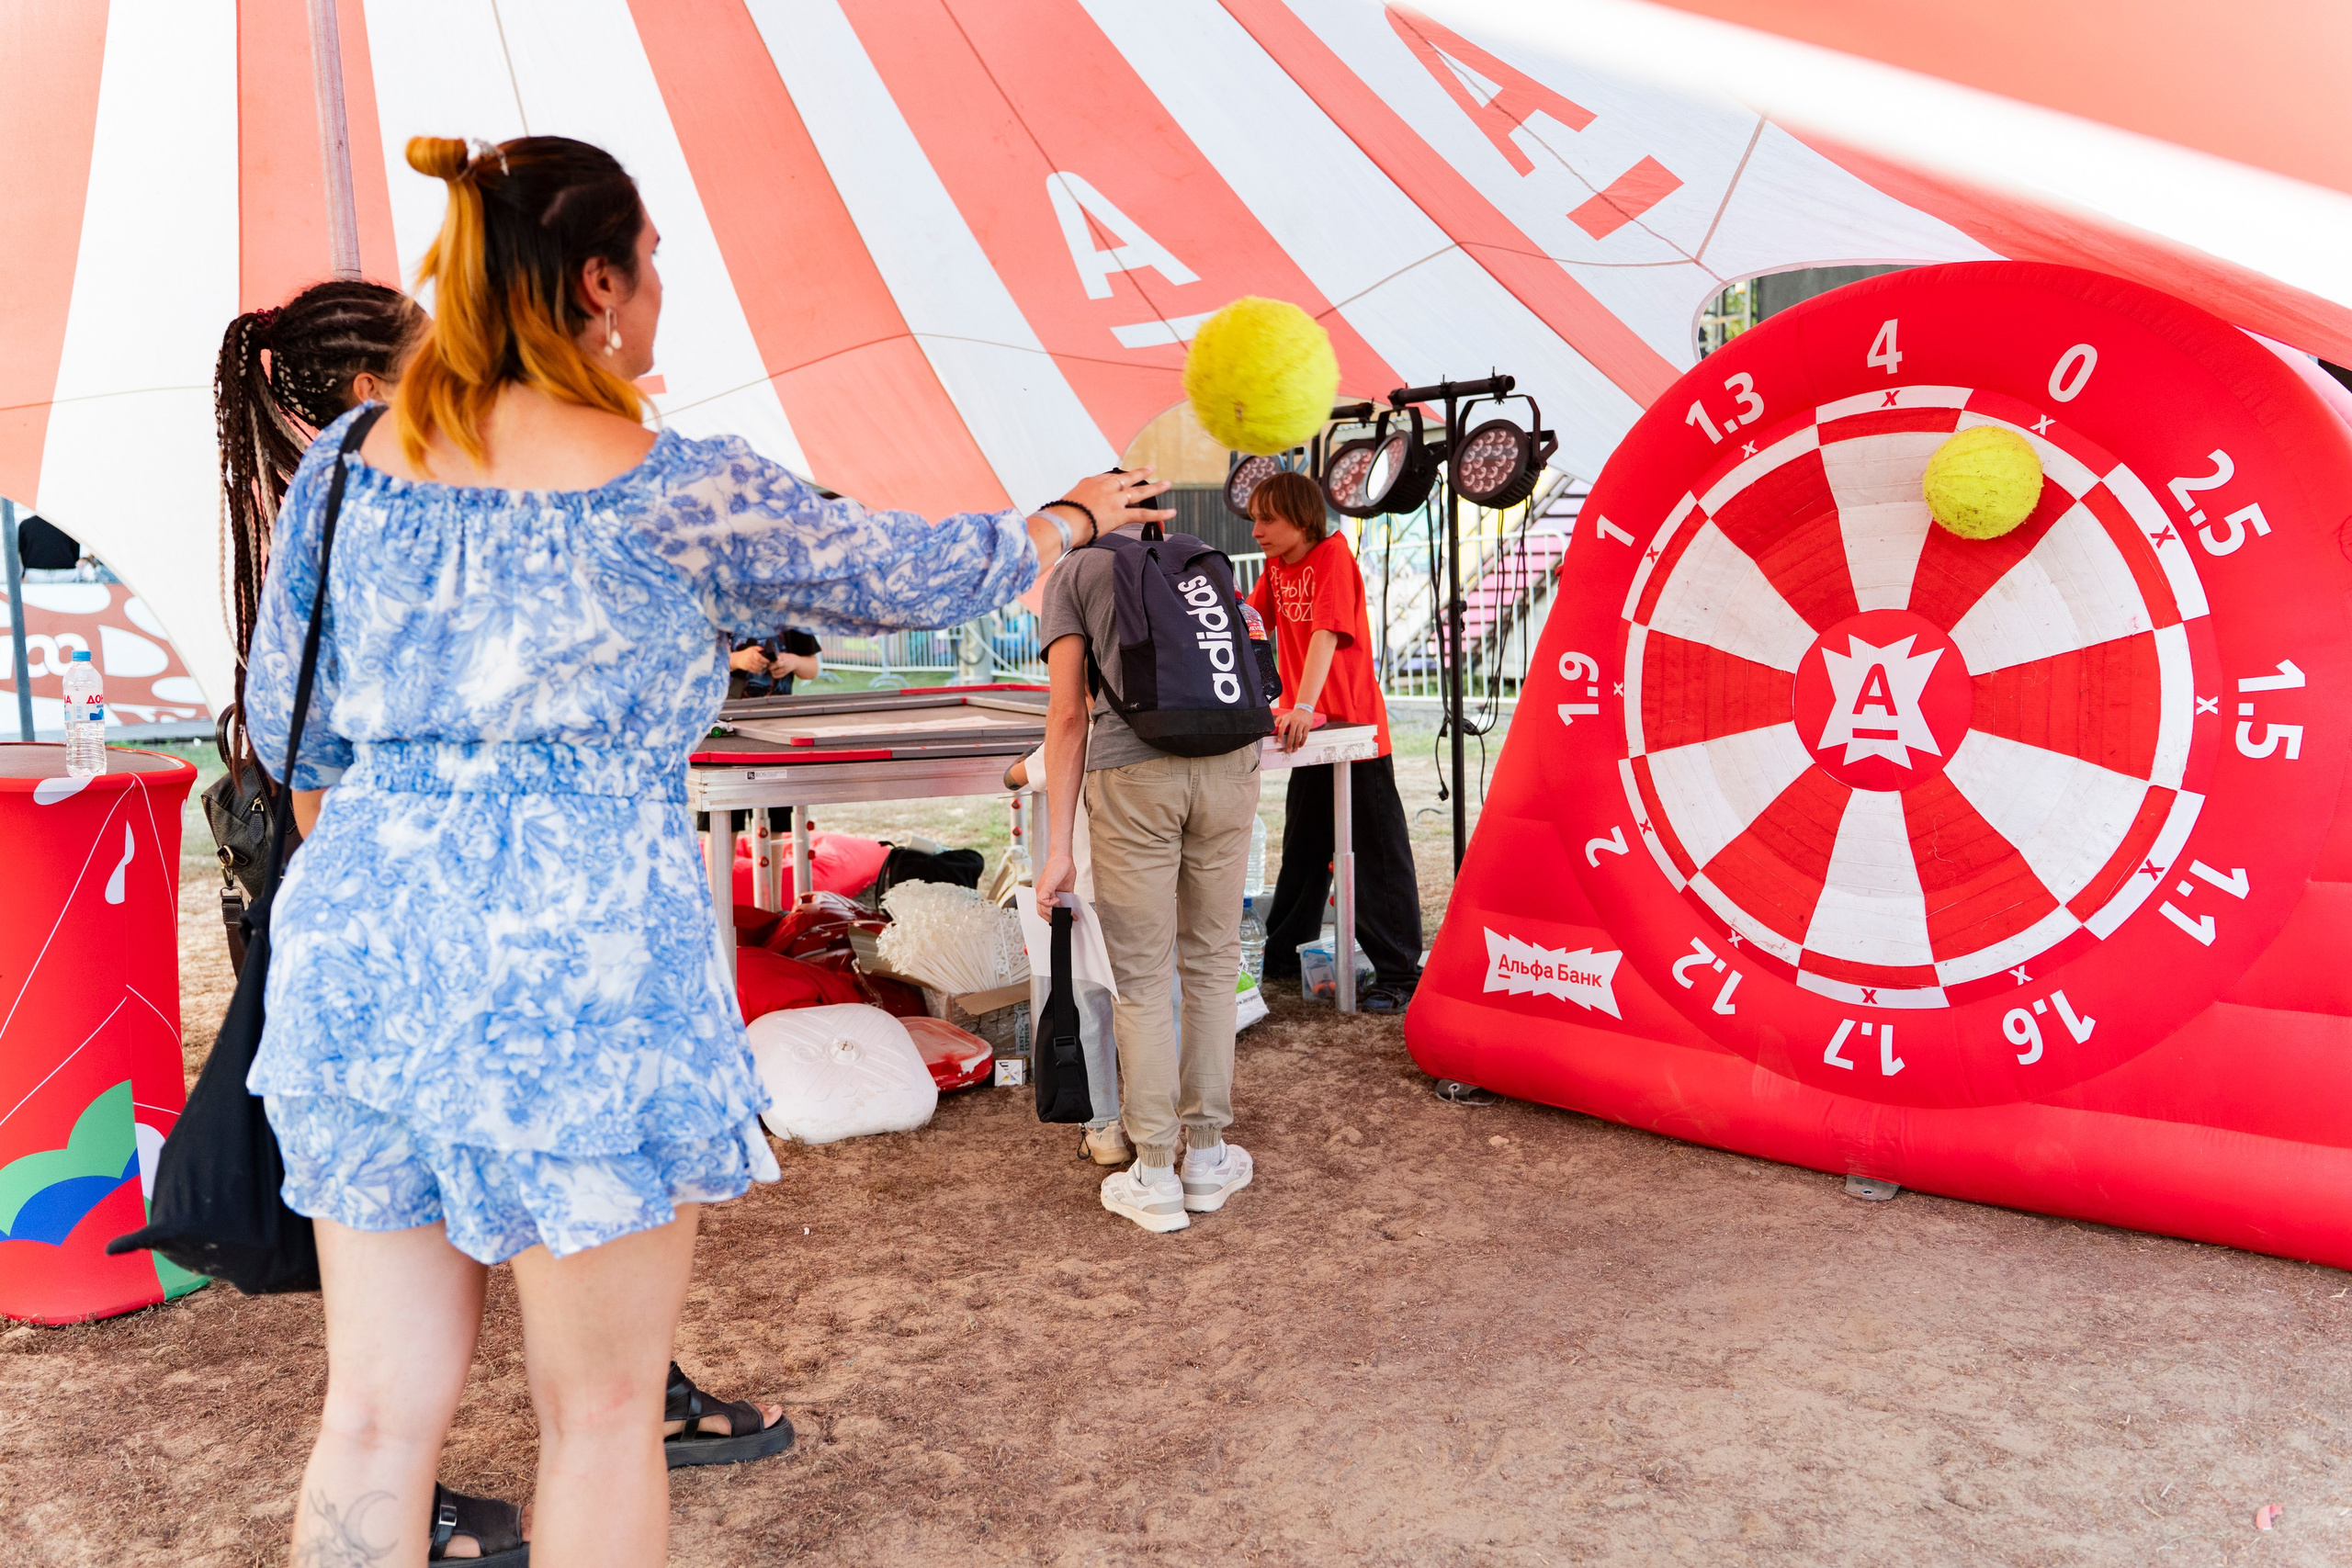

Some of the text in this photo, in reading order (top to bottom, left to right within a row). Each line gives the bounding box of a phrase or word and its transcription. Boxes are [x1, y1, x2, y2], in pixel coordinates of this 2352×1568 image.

[1868, 319, 1902, 374] 4
[2049, 344, 2098, 401] 0
[1686, 373, 1764, 444] 1.3
[1597, 514, 1634, 547] 1
[2167, 449, 2271, 556] 2.5
[1178, 576, 1240, 704] adidas
[1558, 652, 1599, 726] 1.9
[2235, 660, 2305, 760] 1.5
[1586, 826, 1629, 867] 2
[2158, 860, 2249, 946] 1.1
[1498, 953, 1602, 987] Альфа Банк
[1672, 937, 1742, 1014] 1.2
[1824, 1019, 1905, 1076] 1.7
[2003, 990, 2096, 1065] 1.6
